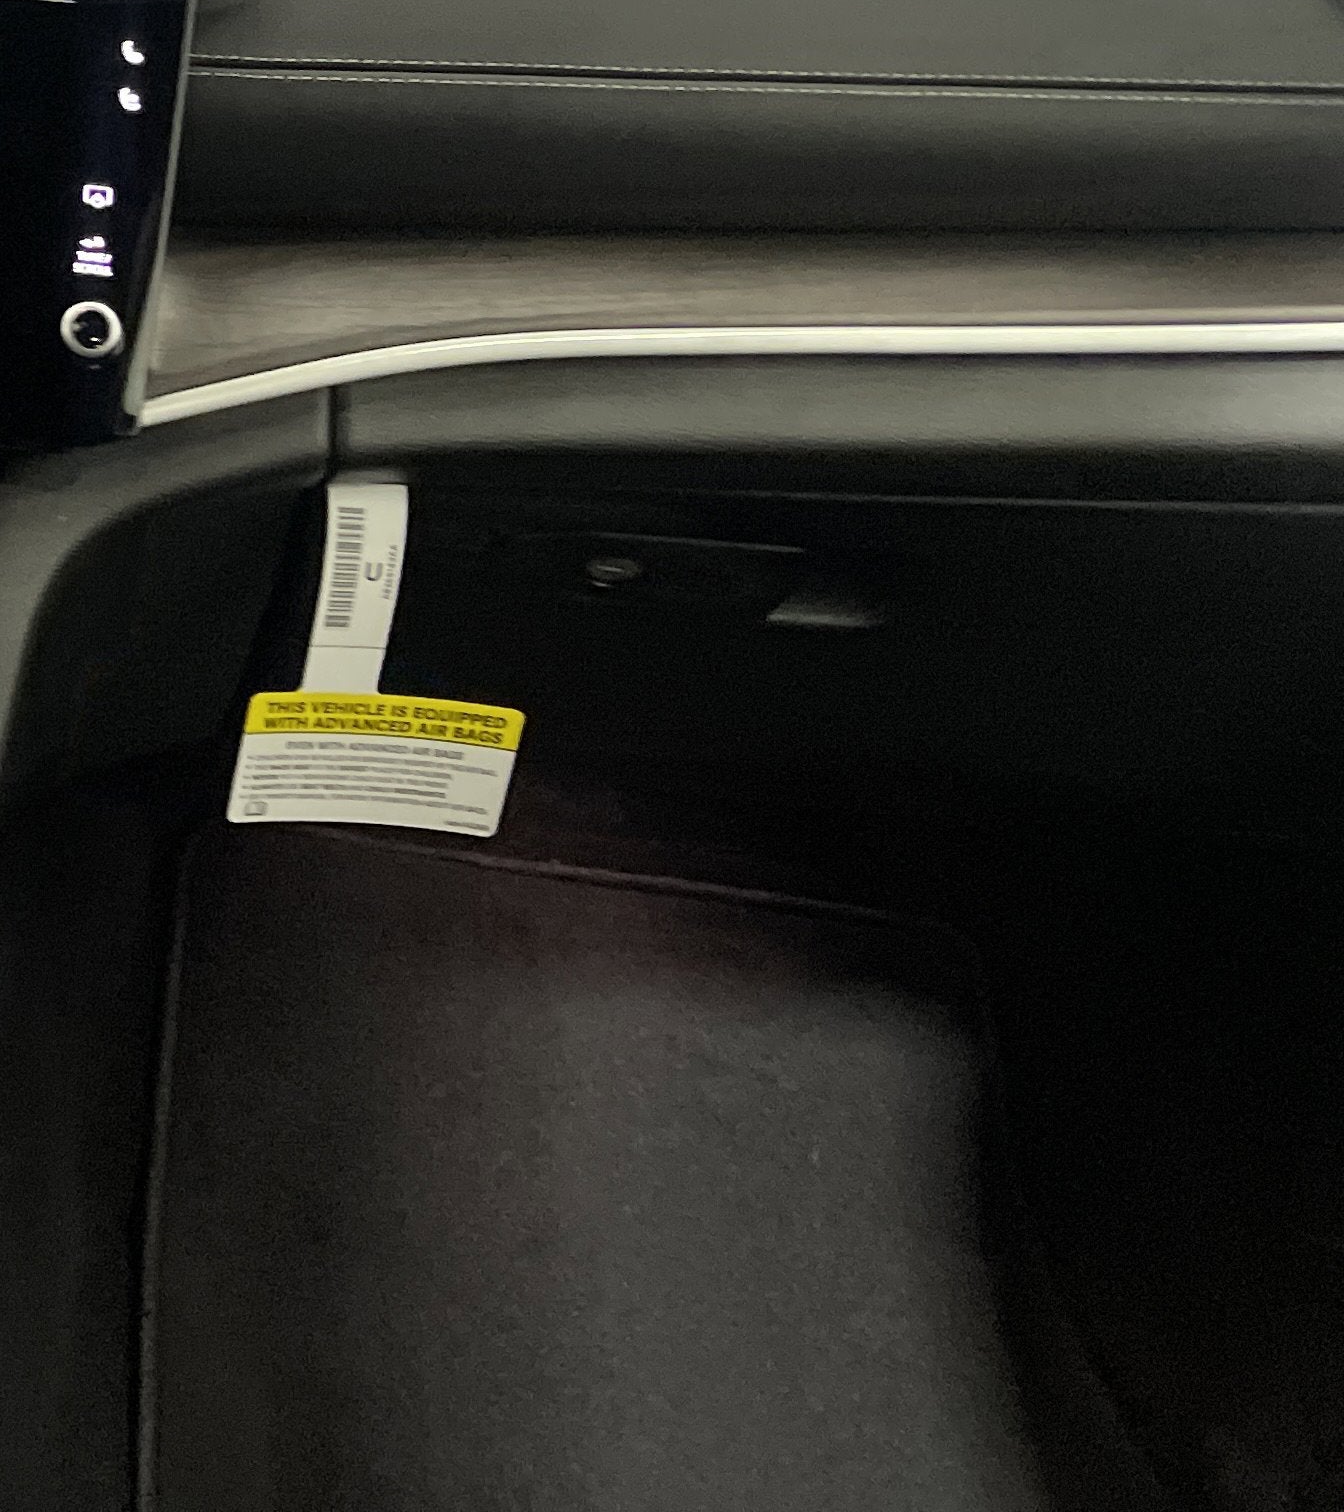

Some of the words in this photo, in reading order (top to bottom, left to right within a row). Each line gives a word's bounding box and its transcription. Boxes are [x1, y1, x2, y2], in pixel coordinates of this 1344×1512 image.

[267, 701, 305, 715] THIS
[311, 702, 386, 717] VEHICLE
[391, 705, 407, 718] IS
[413, 706, 508, 728] EQUIPPED
[263, 717, 309, 730] WITH
[314, 718, 413, 733] ADVANCED
[419, 723, 448, 737] AIR
[453, 726, 505, 745] BAGS
